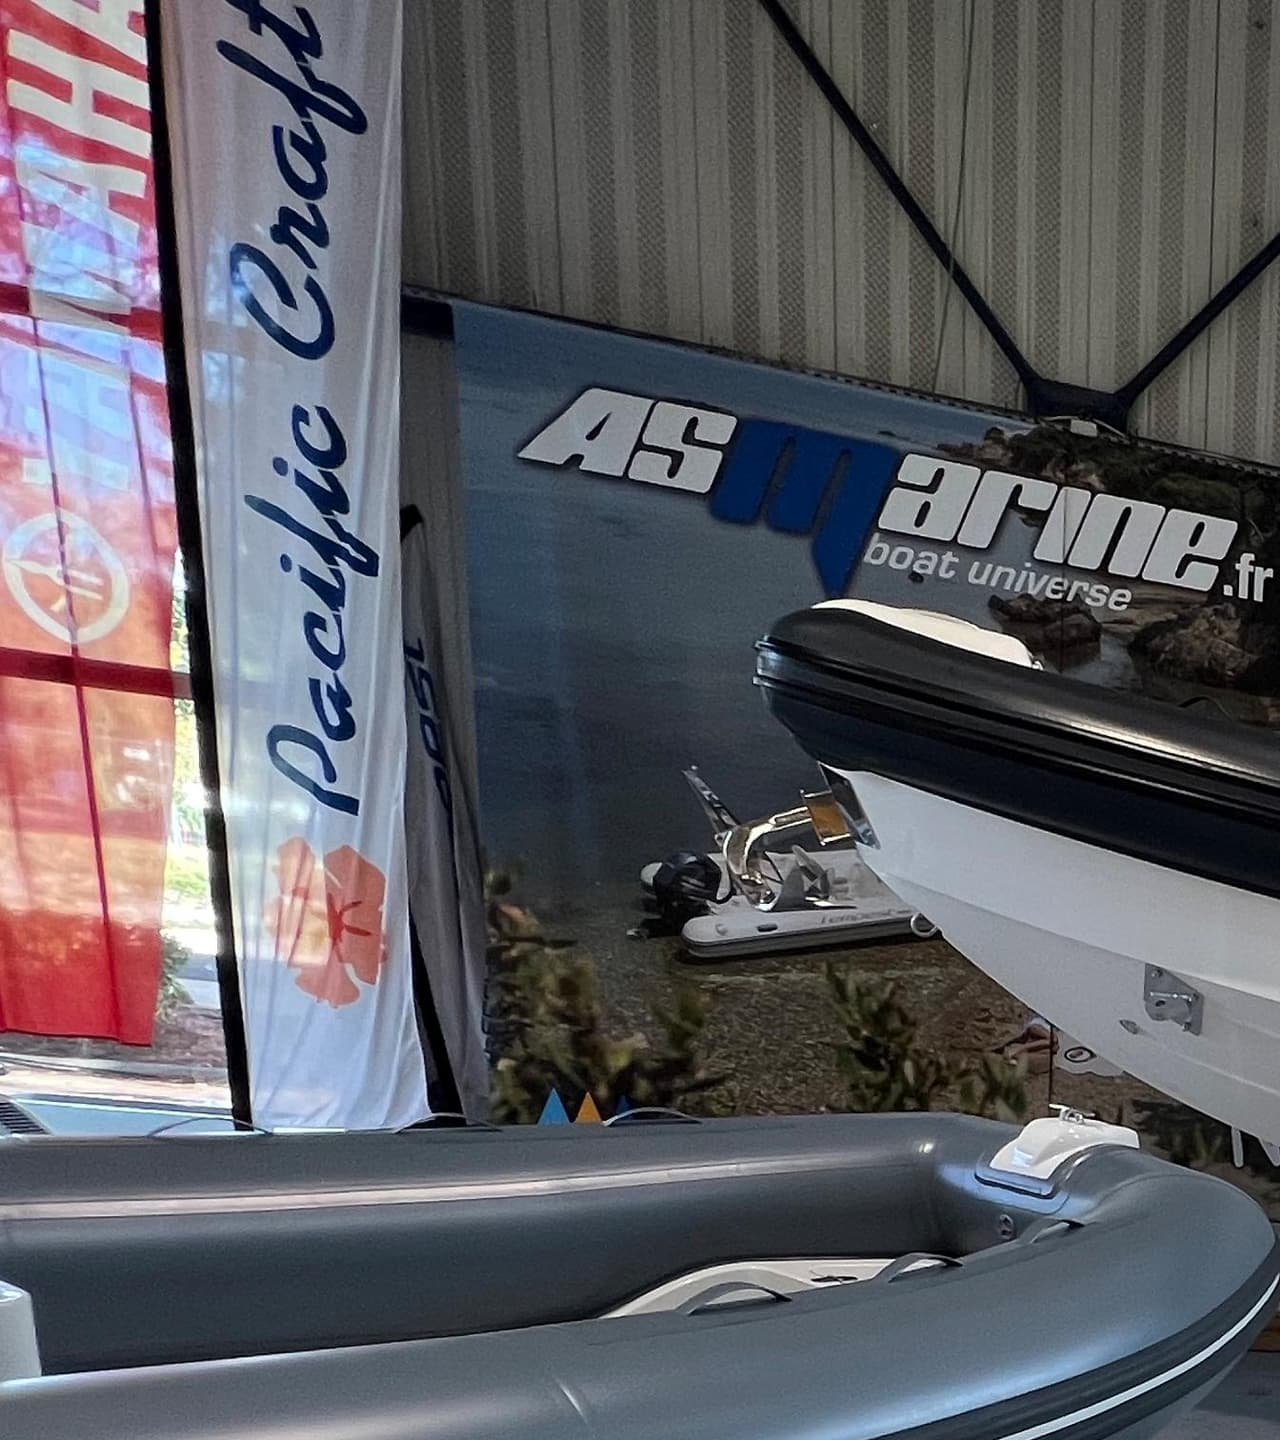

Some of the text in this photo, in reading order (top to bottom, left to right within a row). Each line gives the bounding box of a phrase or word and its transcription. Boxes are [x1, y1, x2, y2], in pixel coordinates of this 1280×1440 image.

[245, 404, 379, 814] Pacific
[863, 532, 1134, 612] boat universe
